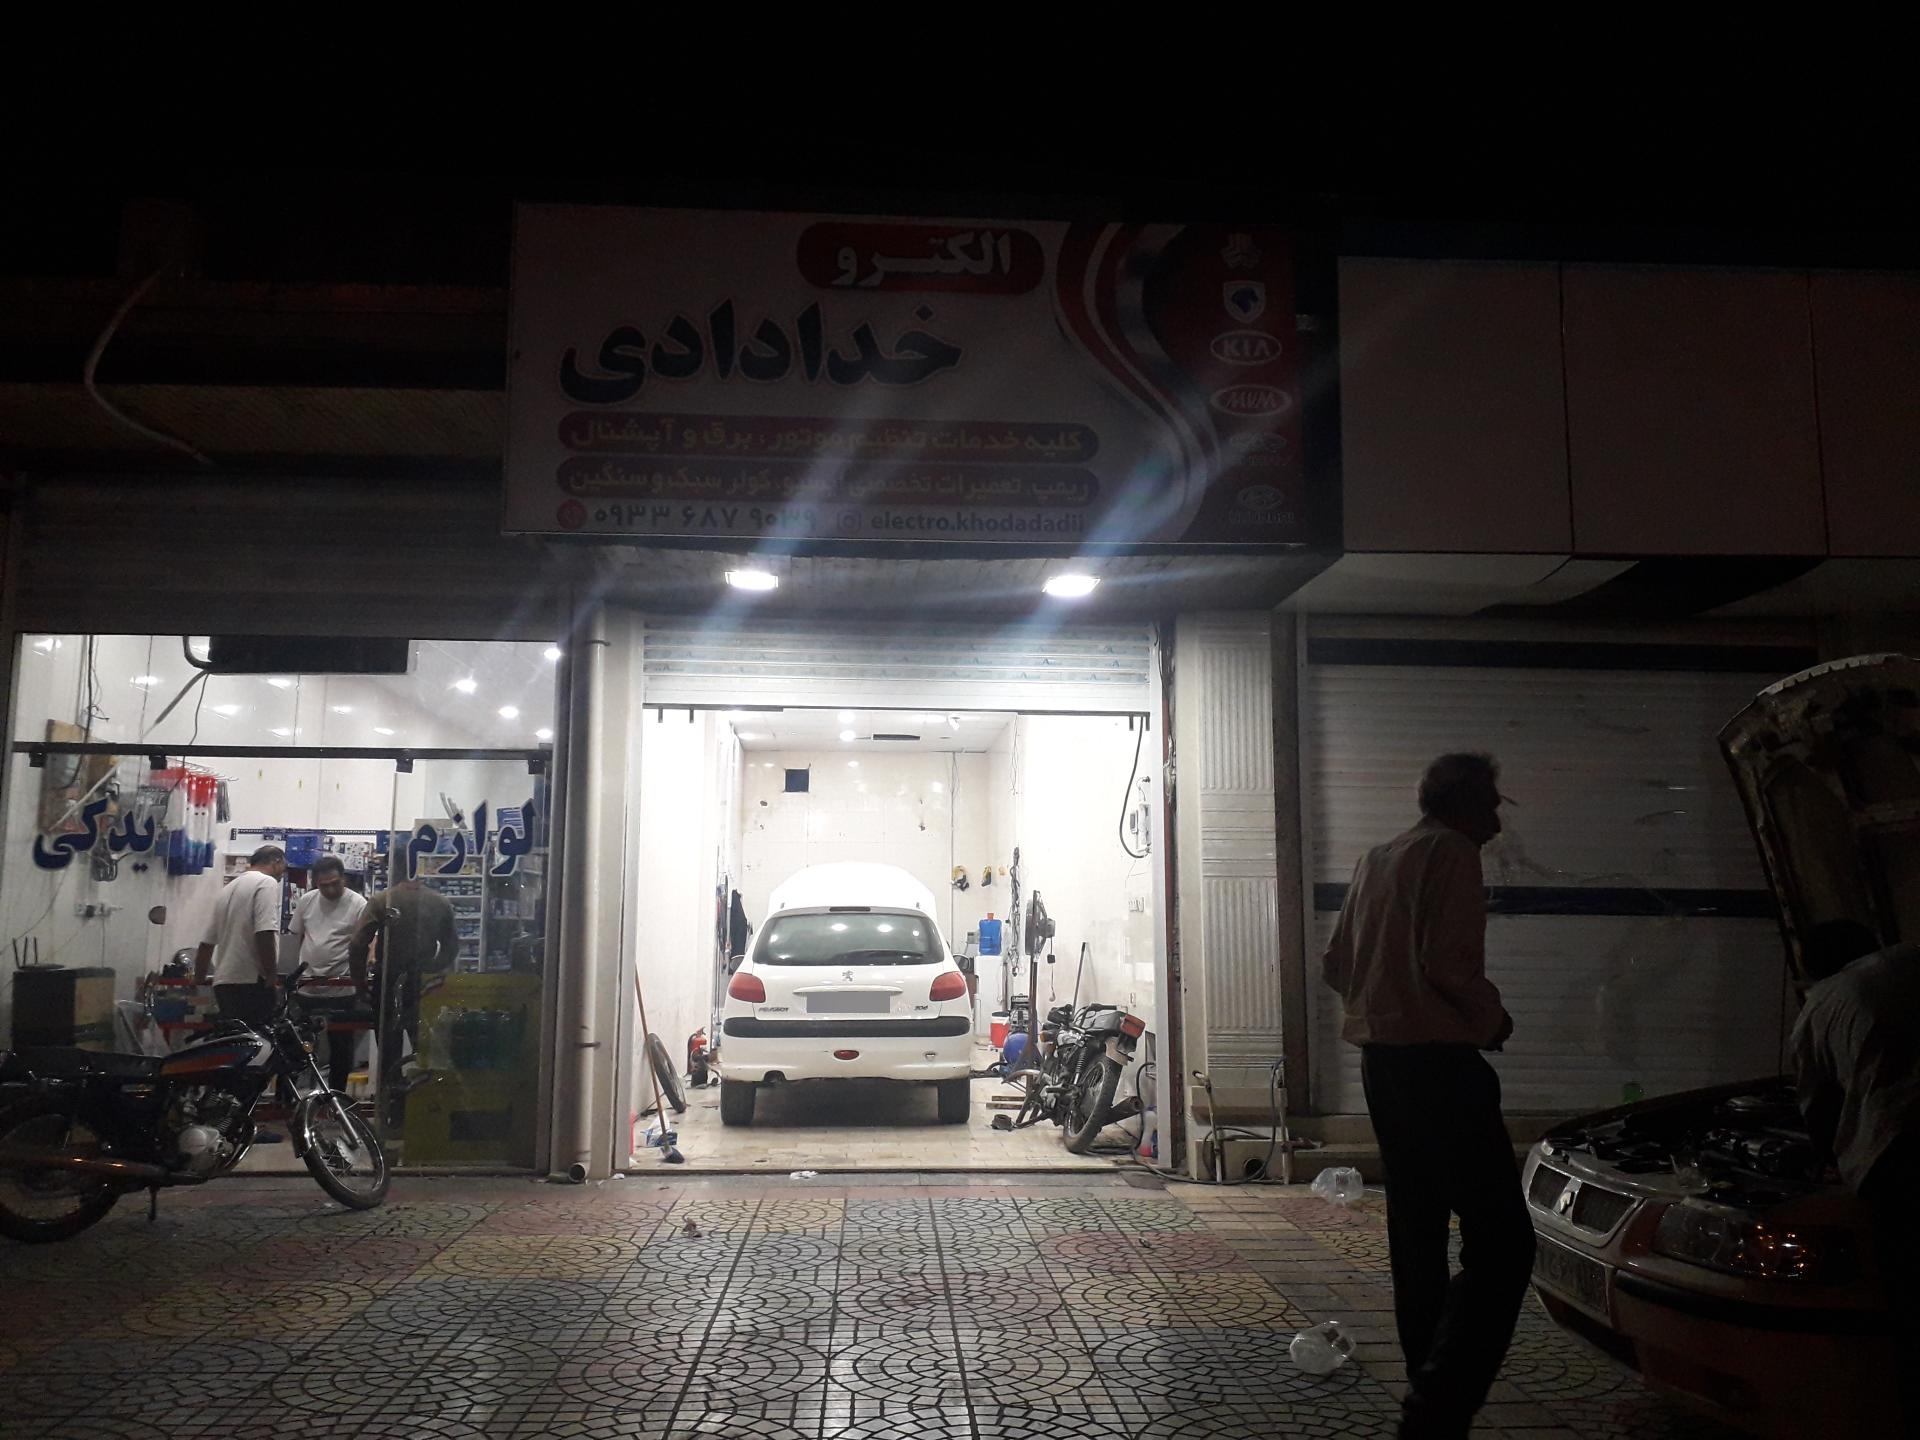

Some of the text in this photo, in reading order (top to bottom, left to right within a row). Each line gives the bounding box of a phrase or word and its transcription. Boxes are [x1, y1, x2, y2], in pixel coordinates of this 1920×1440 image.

[831, 231, 1011, 287] الکترو
[559, 298, 963, 405] خدادادی
[1222, 338, 1272, 357] KIA
[571, 417, 677, 451] آپشنال
[681, 428, 698, 449] و
[702, 421, 753, 450] برق
[932, 428, 1020, 449] خدمات
[1025, 430, 1082, 457] کلیه
[569, 461, 648, 491] سنگین
[651, 473, 664, 493] و
[667, 467, 722, 494] سبک
[726, 468, 771, 495] کولر
[935, 473, 1022, 500] تعمیرات
[594, 504, 671, 526] ۰۹۳۳
[681, 505, 739, 528] ۶۸۷
[32, 797, 538, 881] لوازم یدکی
